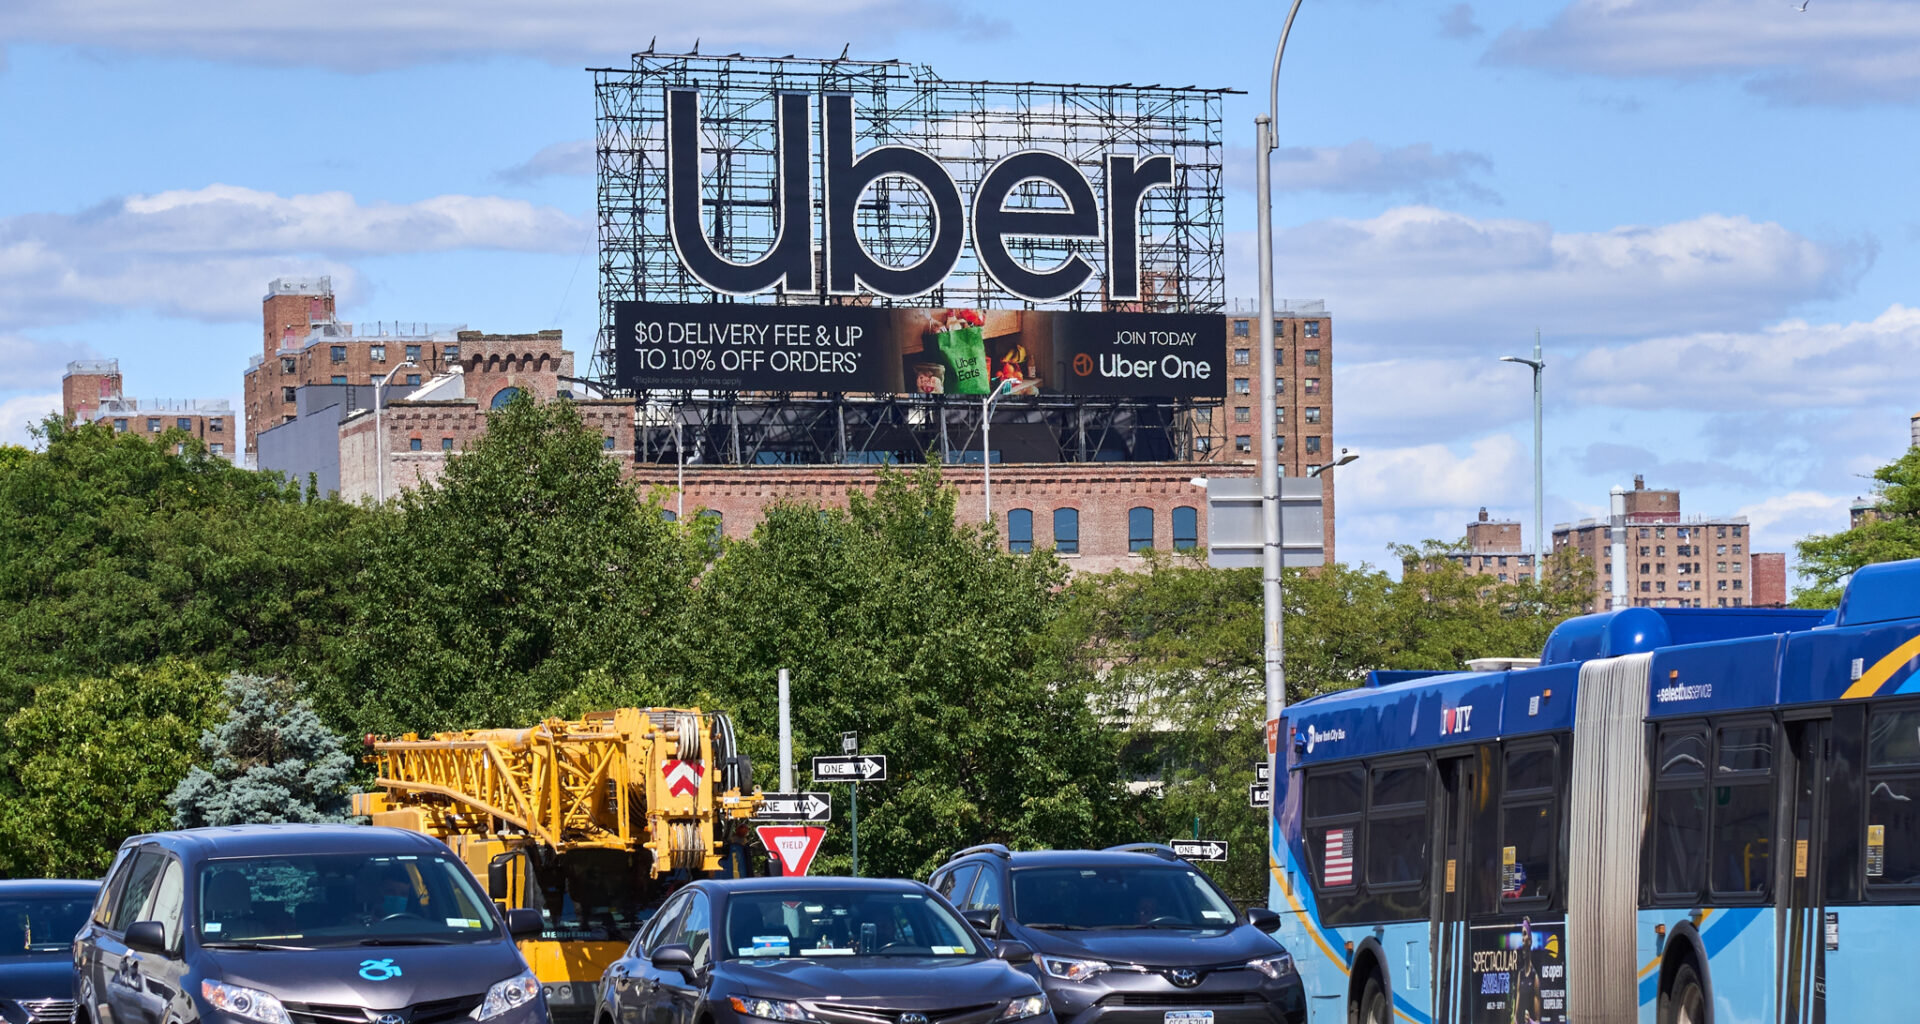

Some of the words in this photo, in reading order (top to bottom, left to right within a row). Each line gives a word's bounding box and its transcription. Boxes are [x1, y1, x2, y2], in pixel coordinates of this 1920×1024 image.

[666, 86, 1175, 301] Uber
[634, 321, 663, 344] $0
[668, 322, 769, 345] DELIVERY
[774, 324, 811, 346] FEE
[815, 325, 831, 346] &
[835, 325, 863, 347] UP
[1113, 331, 1147, 345] JOIN
[1149, 331, 1197, 346] TODAY
[634, 348, 666, 370] TO
[672, 349, 716, 371] 10%
[720, 350, 765, 371] OFF
[955, 356, 978, 370] Uber
[1099, 353, 1156, 378] Uber
[1161, 354, 1211, 380] One
[701, 377, 720, 385] Terms
[958, 369, 980, 382] Eats
[1442, 709, 1448, 735] I
[1454, 706, 1472, 733] NY
[1330, 729, 1338, 742] City
[1338, 728, 1346, 739] Bus
[824, 764, 844, 774] ONE
[854, 763, 875, 773] WAY
[794, 801, 819, 812] WAY
[782, 841, 803, 850] YIELD
[1178, 845, 1195, 854] ONE
[1202, 845, 1219, 854] WAY
[1473, 950, 1517, 972] SPECTACULAR
[1549, 965, 1563, 982] open
